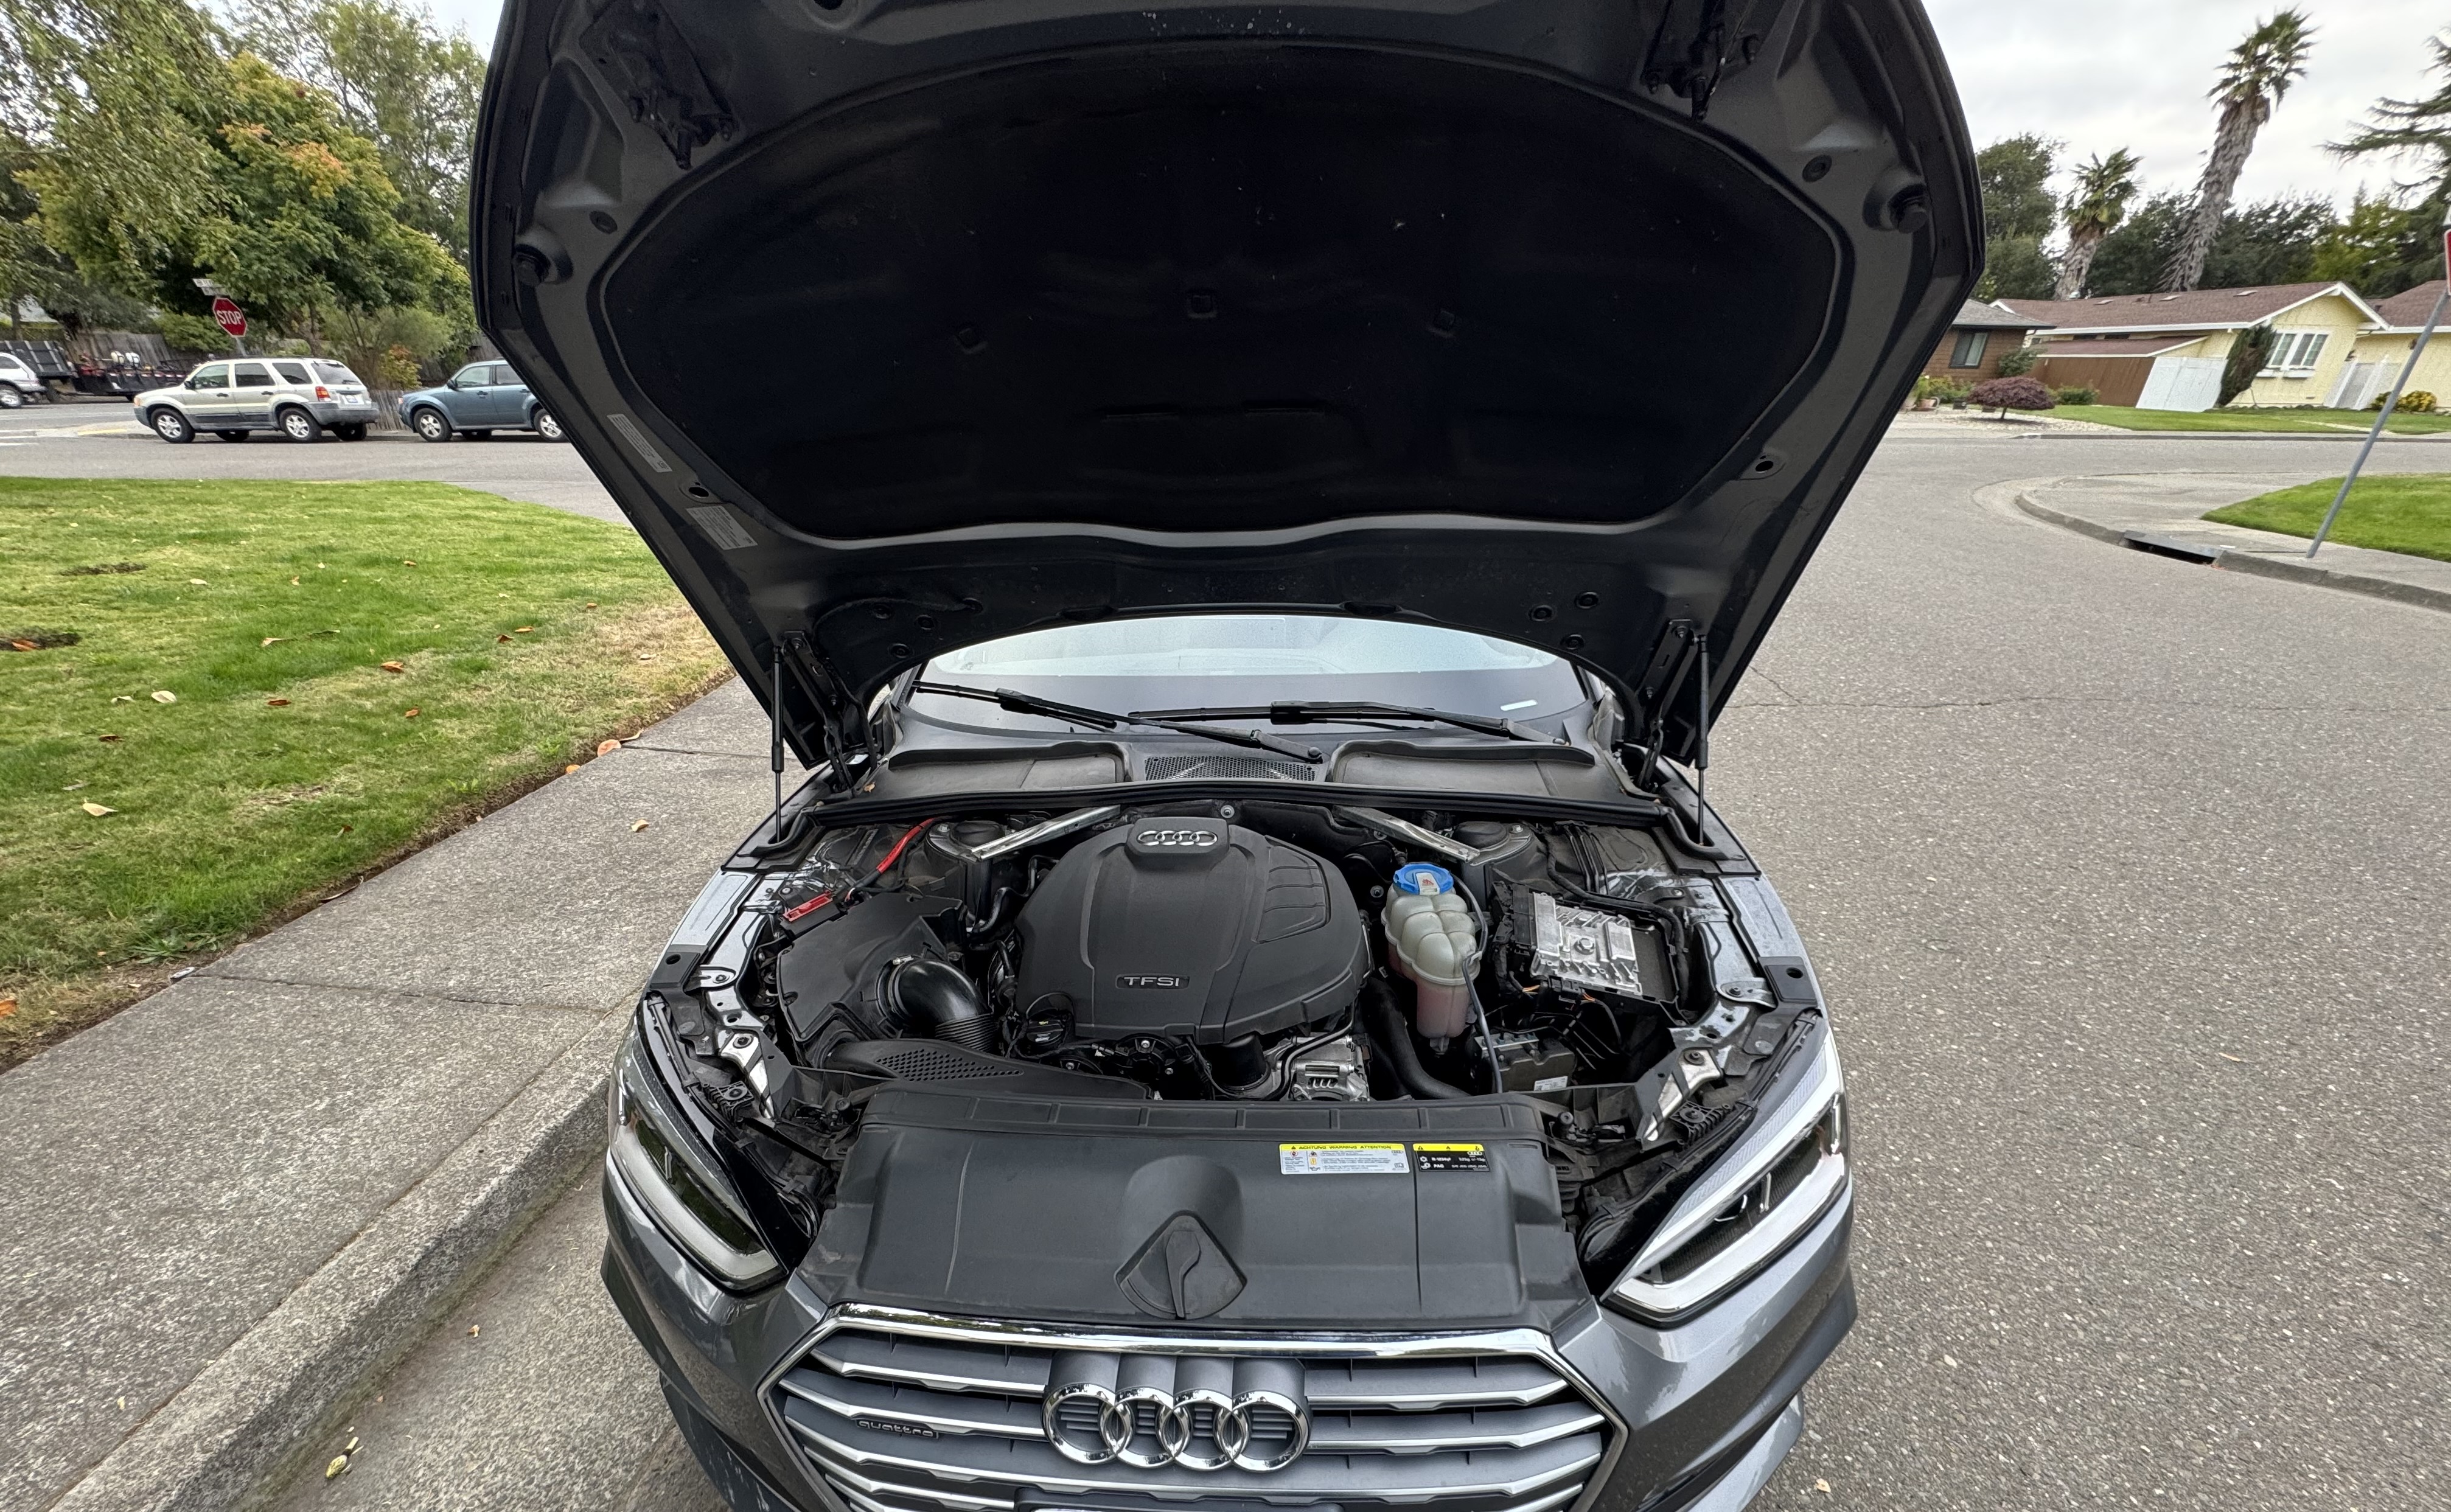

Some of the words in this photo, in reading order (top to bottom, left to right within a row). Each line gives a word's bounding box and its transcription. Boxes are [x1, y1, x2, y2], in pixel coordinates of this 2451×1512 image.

[217, 310, 242, 325] STOP
[1124, 977, 1179, 986] TFSI
[859, 1421, 933, 1437] quattro
